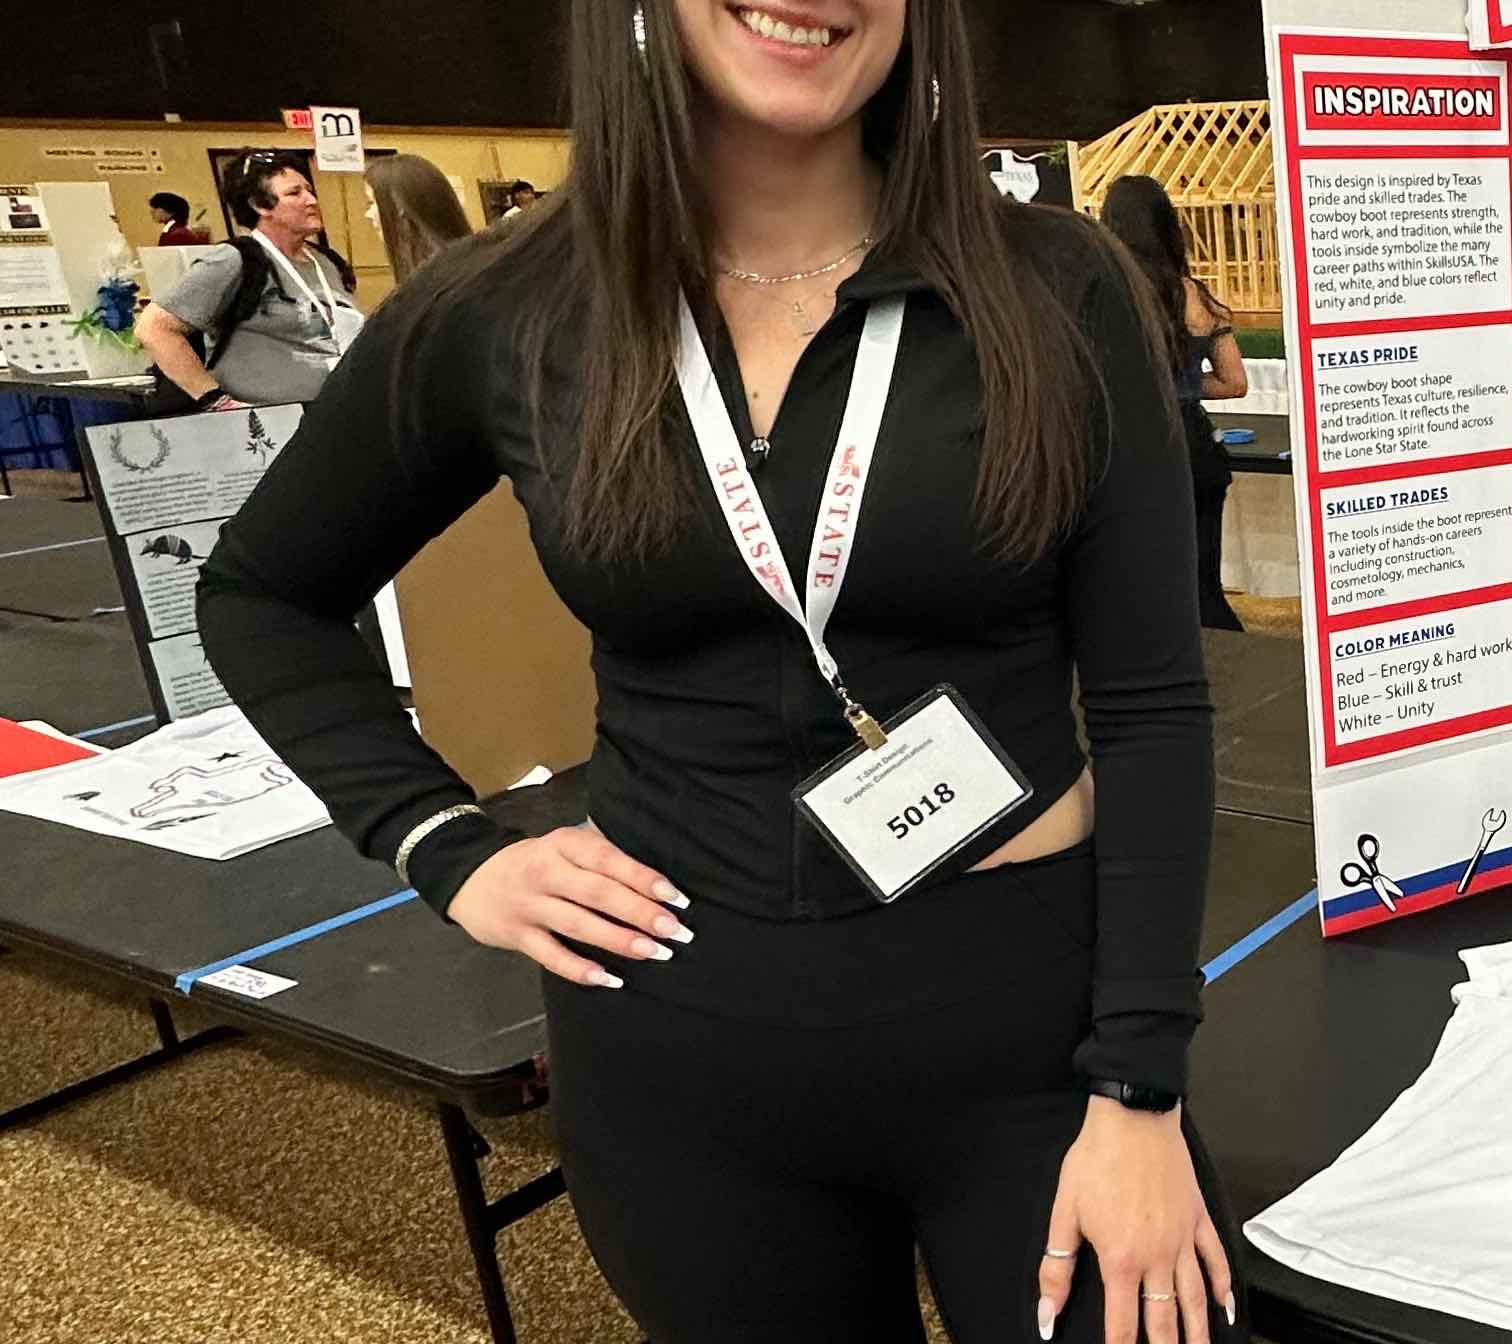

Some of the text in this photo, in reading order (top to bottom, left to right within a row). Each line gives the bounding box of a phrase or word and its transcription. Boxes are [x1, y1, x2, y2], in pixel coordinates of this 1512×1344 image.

[1314, 86, 1493, 116] INSPIRATION
[1307, 172, 1482, 190] This design is inspired by Texas
[1308, 192, 1340, 208] pride
[1343, 191, 1365, 204] and
[1368, 191, 1405, 204] skilled
[1446, 189, 1467, 202] The
[1309, 204, 1499, 225] cowboy boot represents strength,
[1310, 221, 1502, 240] hard work, and tradition, while the
[1311, 239, 1490, 257] tools inside symbolize the many
[1312, 263, 1350, 275] career
[1352, 259, 1385, 275] paths
[1386, 257, 1422, 270] within
[1478, 253, 1499, 265] The
[1314, 270, 1497, 292] red, white, and blue colors reflect
[1314, 291, 1406, 310] unity and pride.
[1317, 345, 1418, 367] TEXAS PRIDE
[1318, 373, 1452, 395] The cowboy boot shape
[1320, 383, 1508, 413] represents Texas culture, resilience,
[1321, 414, 1343, 428] and
[1399, 409, 1407, 420] It
[1410, 405, 1449, 418] reflects
[1451, 402, 1469, 414] the
[1321, 416, 1493, 444] hardworking spirit found across
[1322, 439, 1430, 461] the Lone Star State.
[716, 457, 770, 557] STATE
[1326, 486, 1448, 515] SKILLED TRADES
[814, 482, 855, 588] STATE
[1327, 505, 1512, 544] The tools inside the boot represent
[1328, 526, 1482, 559] a variety of hands-on careers
[1329, 546, 1455, 573] including construction,
[1330, 559, 1464, 590] cosmetology, mechanics,
[1331, 590, 1352, 605] and
[1335, 622, 1454, 657] COLOR MEANING
[1336, 637, 1512, 687] Red Energy & hard work
[1337, 671, 1462, 710] Blue Skill & trust
[1338, 701, 1434, 732] White Unity
[886, 782, 955, 840] 5018
